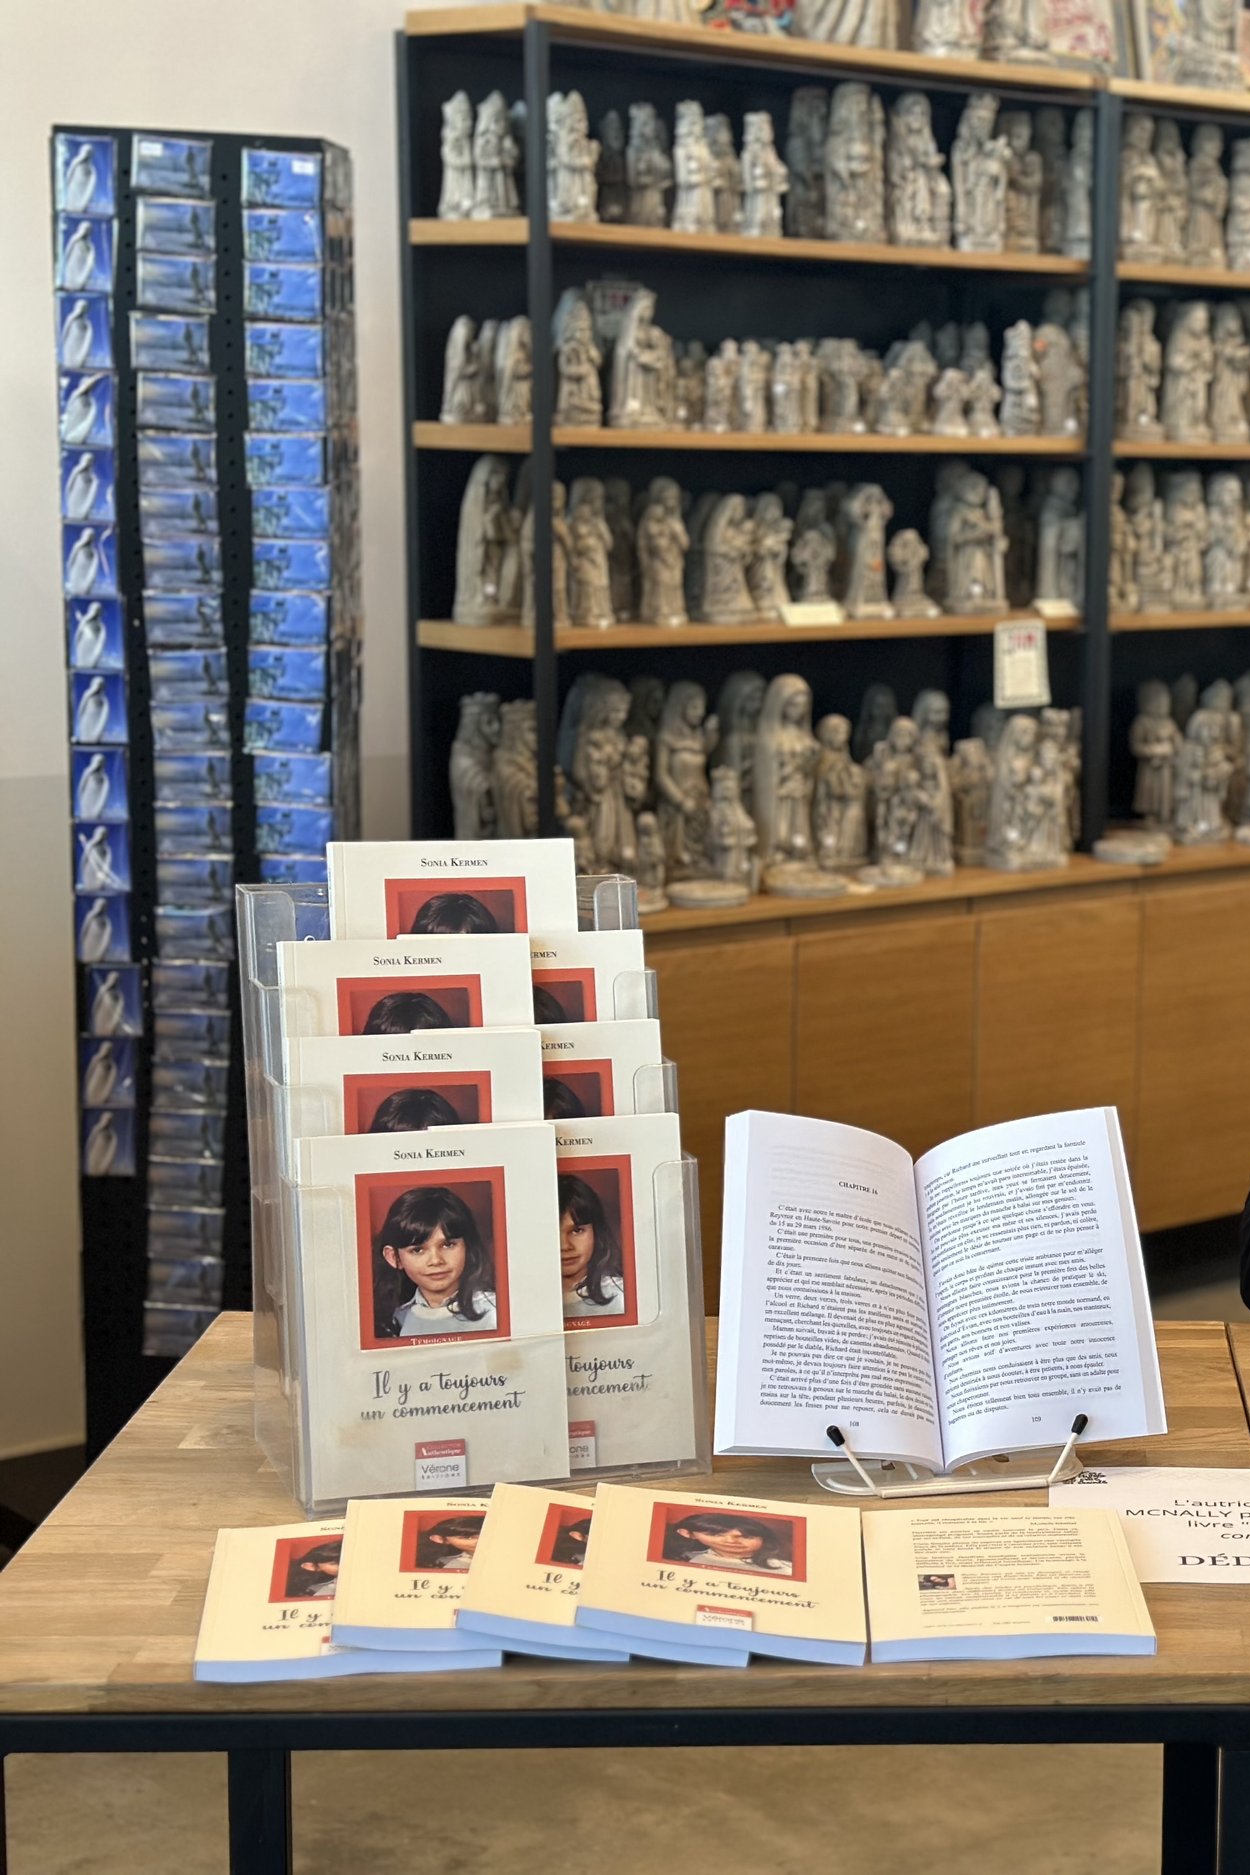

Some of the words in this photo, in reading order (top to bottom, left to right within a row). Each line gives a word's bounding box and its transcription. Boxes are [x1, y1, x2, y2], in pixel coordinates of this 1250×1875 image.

[450, 857, 488, 867] KERMEN
[403, 955, 442, 965] KERMEN
[413, 1051, 453, 1061] KERMEN
[426, 1149, 465, 1159] KERMEN
[565, 1355, 635, 1383] toujours
[373, 1370, 392, 1399] Il
[398, 1384, 411, 1405] y
[419, 1381, 431, 1392] a
[431, 1372, 507, 1400] toujours
[360, 1410, 385, 1421] un
[392, 1390, 526, 1419] commencement
[1126, 1509, 1232, 1518] MCNALLY
[1188, 1520, 1234, 1528] livre
[544, 1572, 563, 1584] Il
[657, 1570, 676, 1581] Il
[719, 1581, 800, 1598] toujours
[412, 1579, 430, 1591] Il
[641, 1582, 668, 1590] un
[675, 1586, 820, 1609] commencement
[280, 1609, 299, 1621] Il
